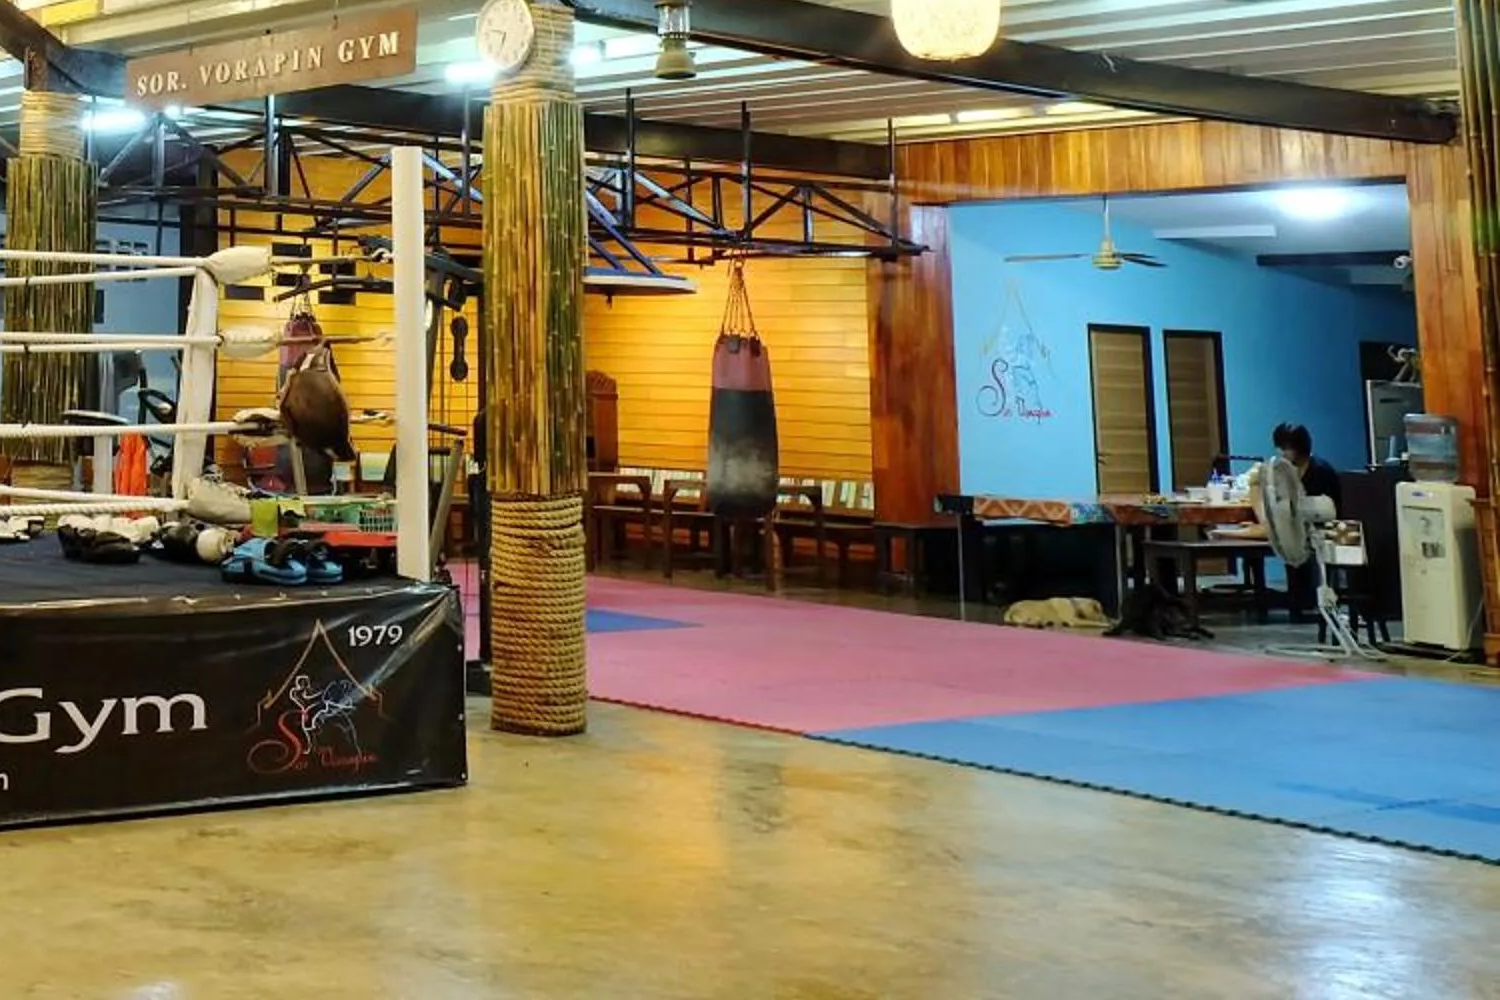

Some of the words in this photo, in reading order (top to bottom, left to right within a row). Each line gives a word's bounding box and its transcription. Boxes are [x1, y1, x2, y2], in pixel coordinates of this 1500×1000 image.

[136, 70, 188, 98] SOR.
[199, 46, 324, 86] VORAPIN
[337, 30, 401, 65] GYM
[348, 624, 404, 648] 1979
